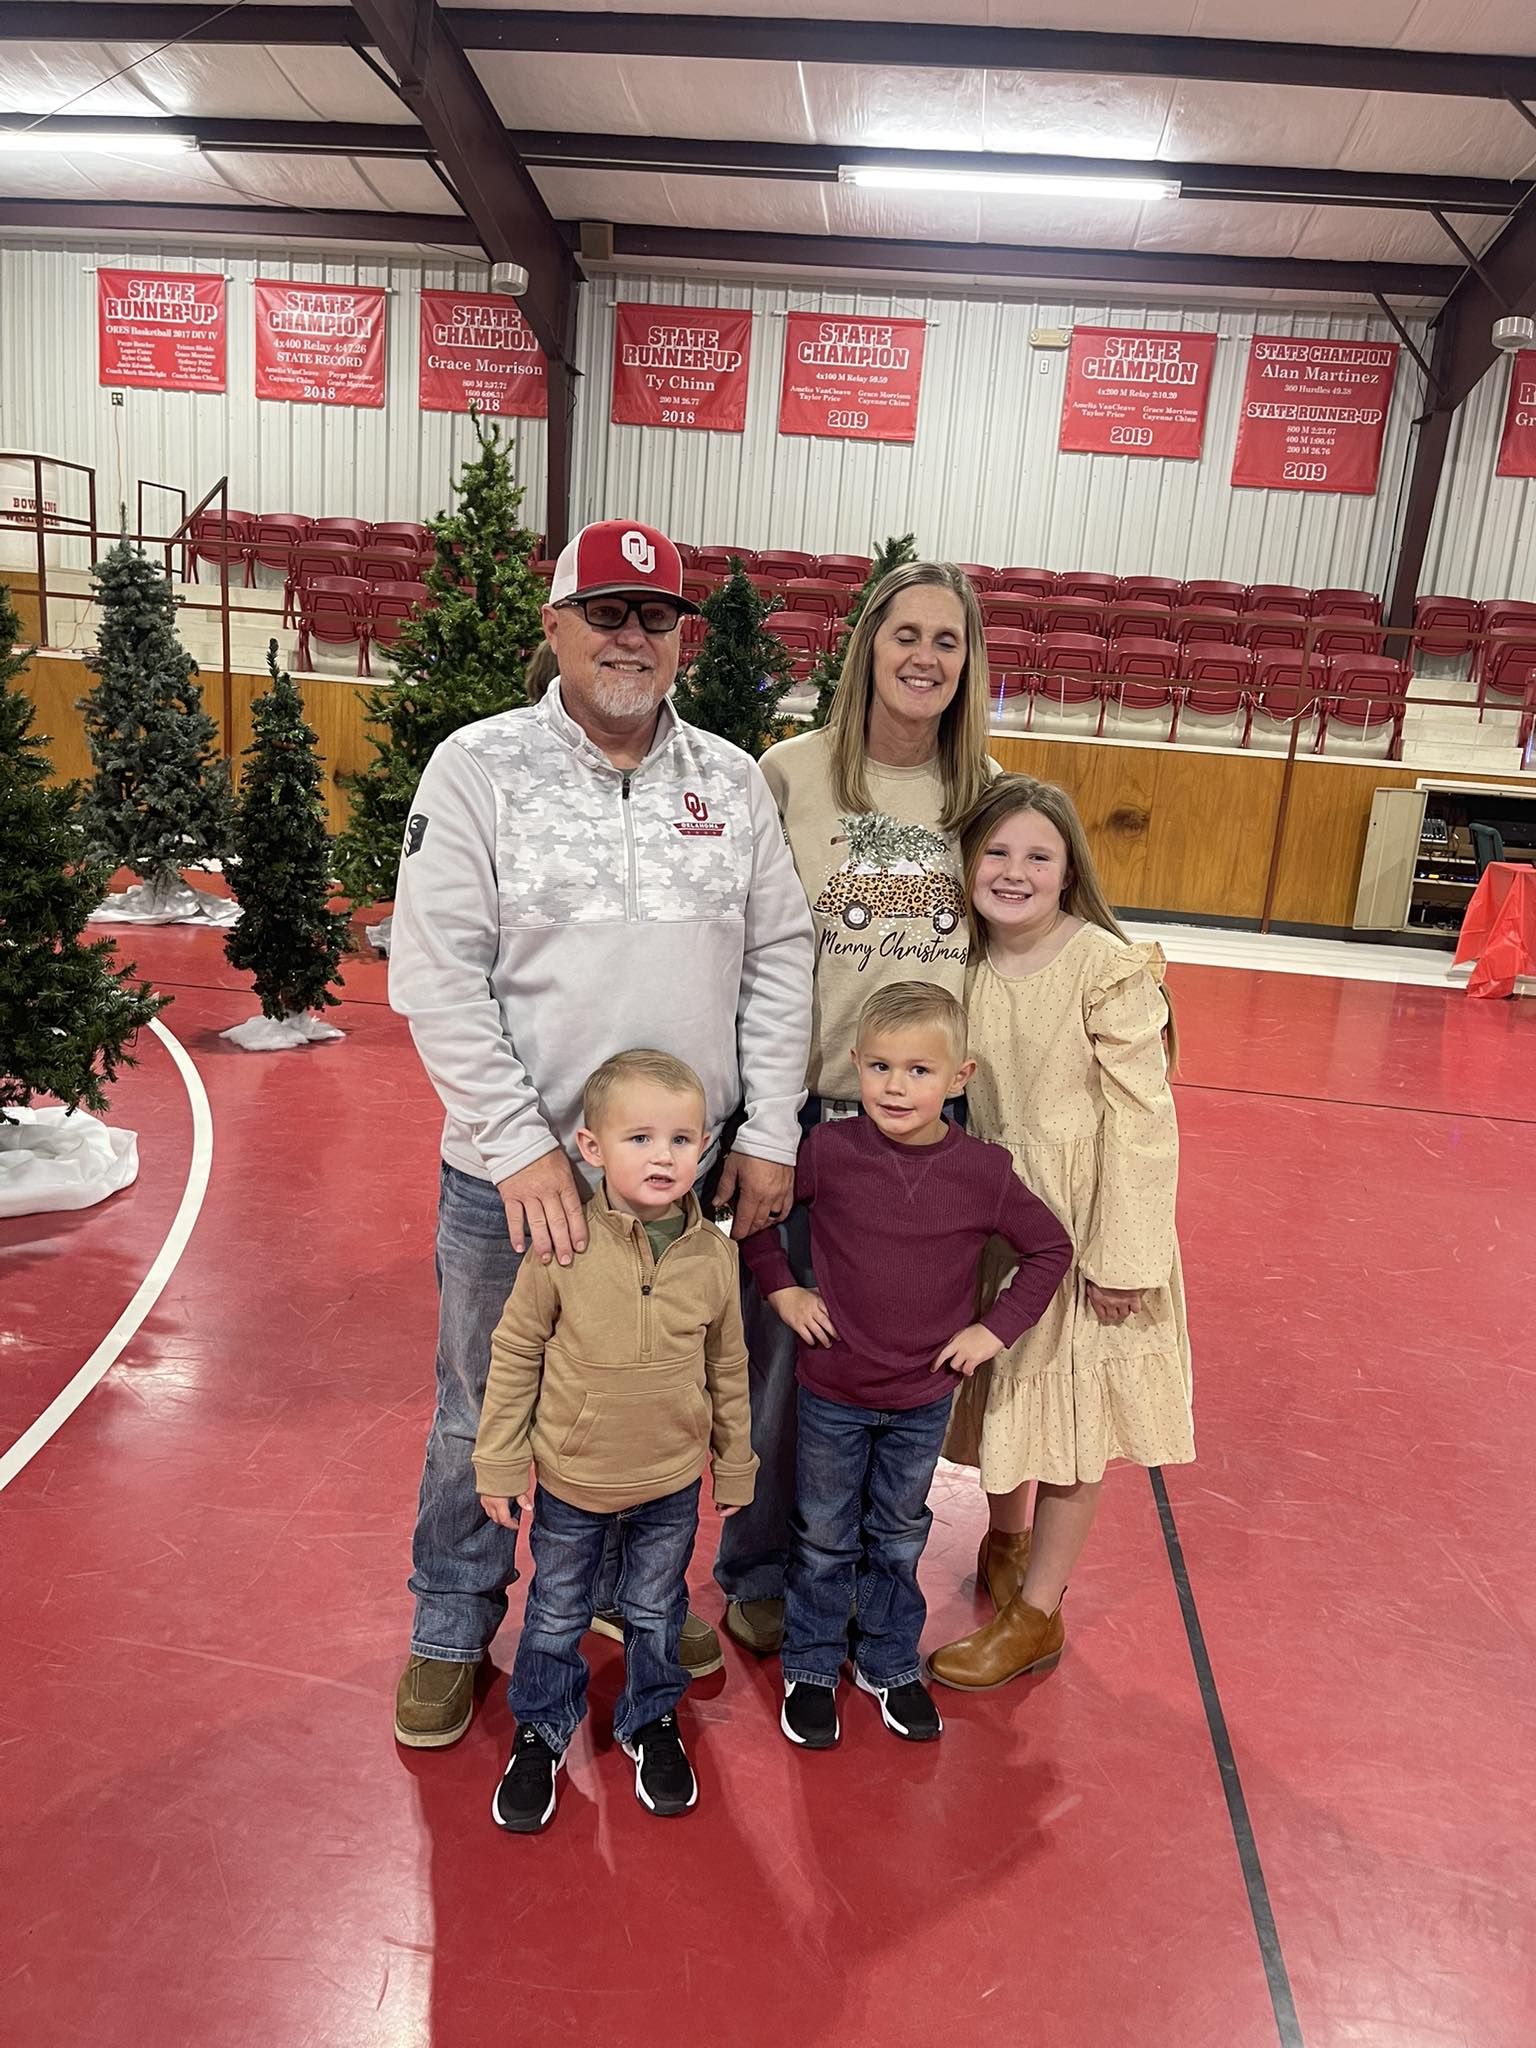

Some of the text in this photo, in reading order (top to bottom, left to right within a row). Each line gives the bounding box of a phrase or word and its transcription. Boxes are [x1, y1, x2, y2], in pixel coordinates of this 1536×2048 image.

[128, 280, 194, 302] STATE
[106, 298, 217, 324] RUNNER-UP
[287, 292, 354, 315] STATE
[268, 310, 372, 339] CHAMPION
[452, 305, 521, 329] STATE
[131, 327, 172, 337] Basketball
[433, 324, 538, 351] CHAMPION
[648, 325, 719, 350] STATE
[819, 322, 892, 348] STATE
[274, 338, 301, 349] 4x400
[303, 339, 332, 353] Relay
[798, 341, 909, 370] CHAMPION
[1105, 336, 1181, 363] STATE
[1256, 342, 1392, 366] STATE CHAMPION
[277, 352, 362, 367] STATE RECORD
[428, 355, 543, 375] Grace Morrison
[623, 344, 742, 372] RUNNER-UP
[847, 374, 868, 384] Relay
[1082, 356, 1199, 385] CHAMPION
[1261, 364, 1379, 384] Alan Martinez
[304, 385, 336, 399] 2018
[645, 374, 715, 391] Ty Chinn
[1299, 385, 1331, 394] Hurdles
[1129, 389, 1151, 399] Relay
[662, 410, 695, 424] 2018
[828, 409, 869, 429] 2019
[1247, 402, 1382, 424] STATE RUNNER-UP
[1110, 426, 1153, 446] 2019
[1300, 436, 1308, 444] M
[1301, 426, 1309, 434] M
[1301, 446, 1310, 454] M
[1283, 461, 1327, 481] 2019
[621, 530, 656, 574] OU
[684, 792, 709, 822] OU
[820, 928, 968, 972] Merry Christmas
